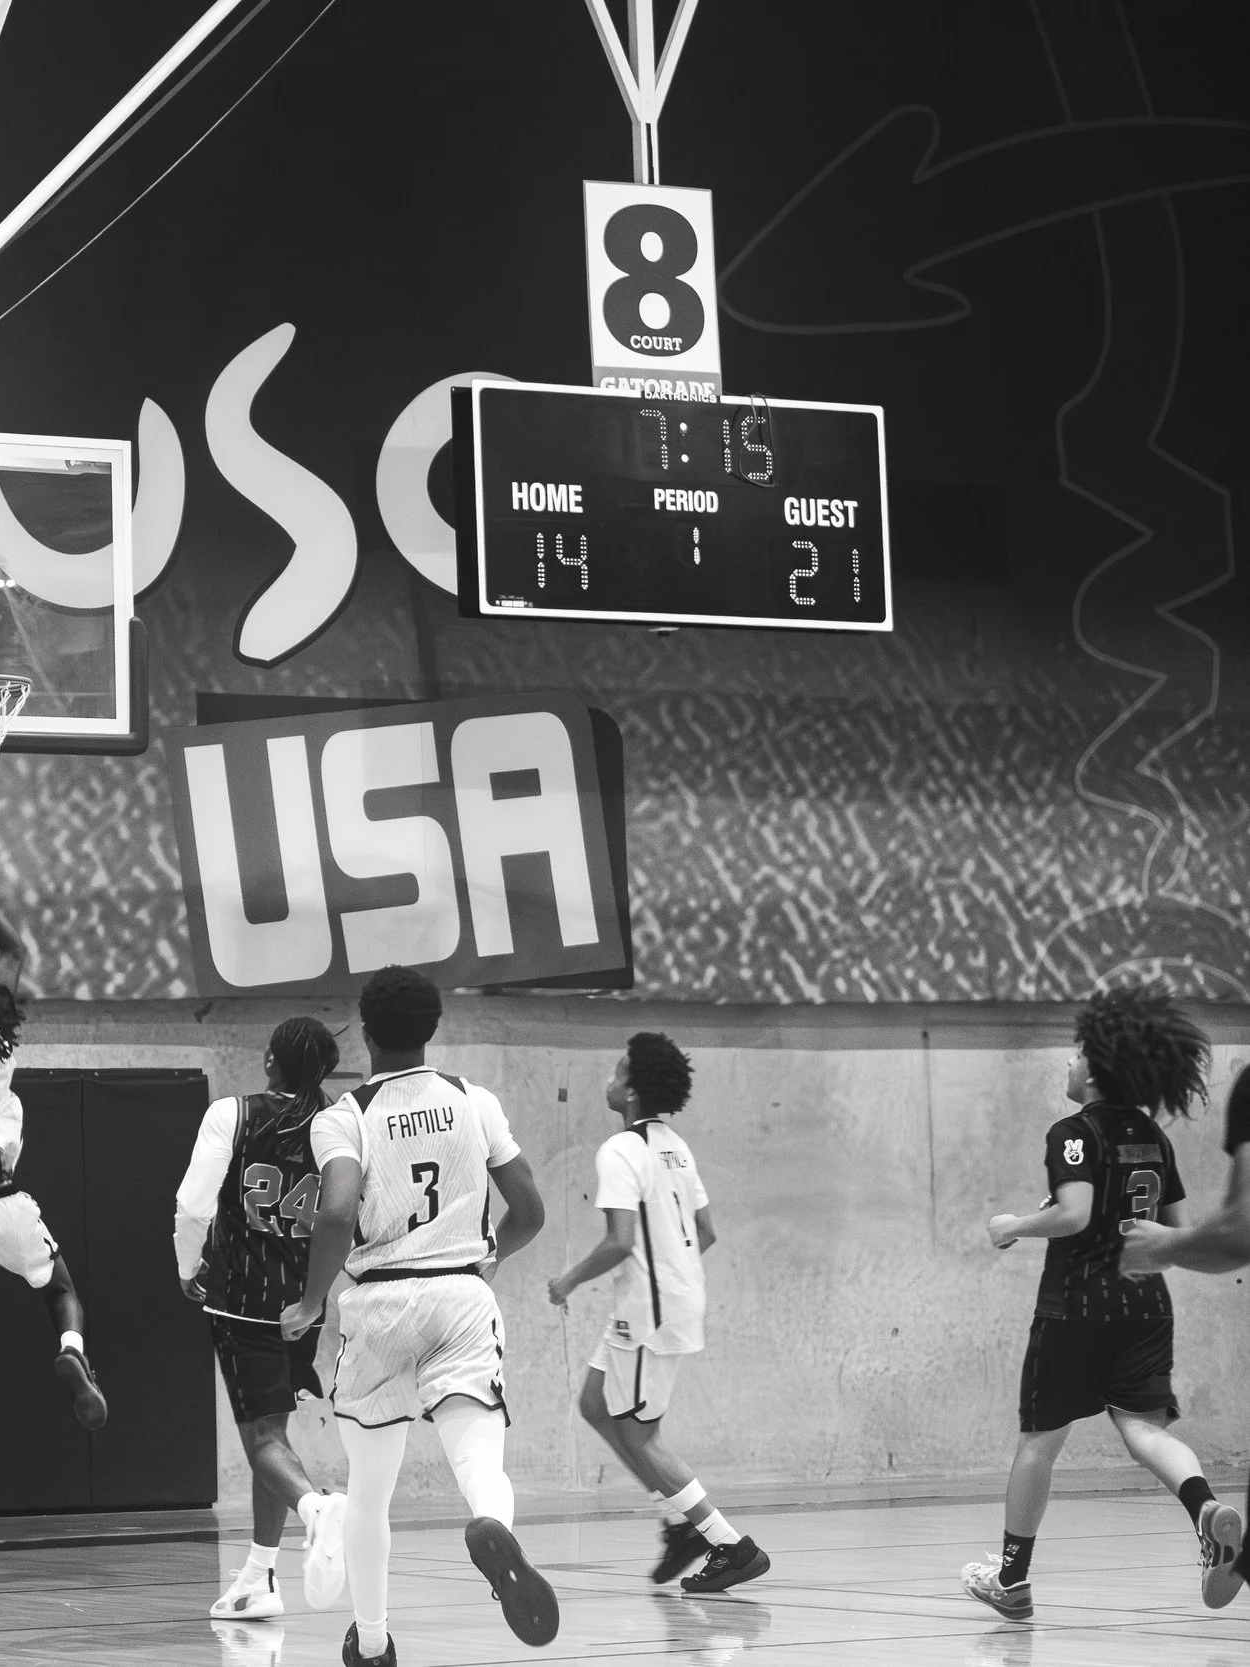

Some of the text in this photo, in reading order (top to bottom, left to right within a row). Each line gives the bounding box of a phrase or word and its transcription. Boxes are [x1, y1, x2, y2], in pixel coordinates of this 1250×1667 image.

[603, 203, 705, 357] 8
[630, 335, 683, 351] COURT
[600, 376, 716, 396] GATORADE
[644, 391, 718, 404] DAKTRONICS
[640, 408, 774, 481] 7:15
[511, 481, 584, 514] HOME
[653, 487, 719, 514] PERIOD
[783, 496, 859, 528] GUEST
[536, 532, 589, 590] 14
[693, 526, 701, 566] 1
[788, 540, 861, 603] 21
[184, 711, 600, 988] USA
[387, 1105, 455, 1141] FAMILY
[244, 1162, 322, 1238] 24
[408, 1161, 440, 1233] 3
[1118, 1169, 1161, 1236] 3
